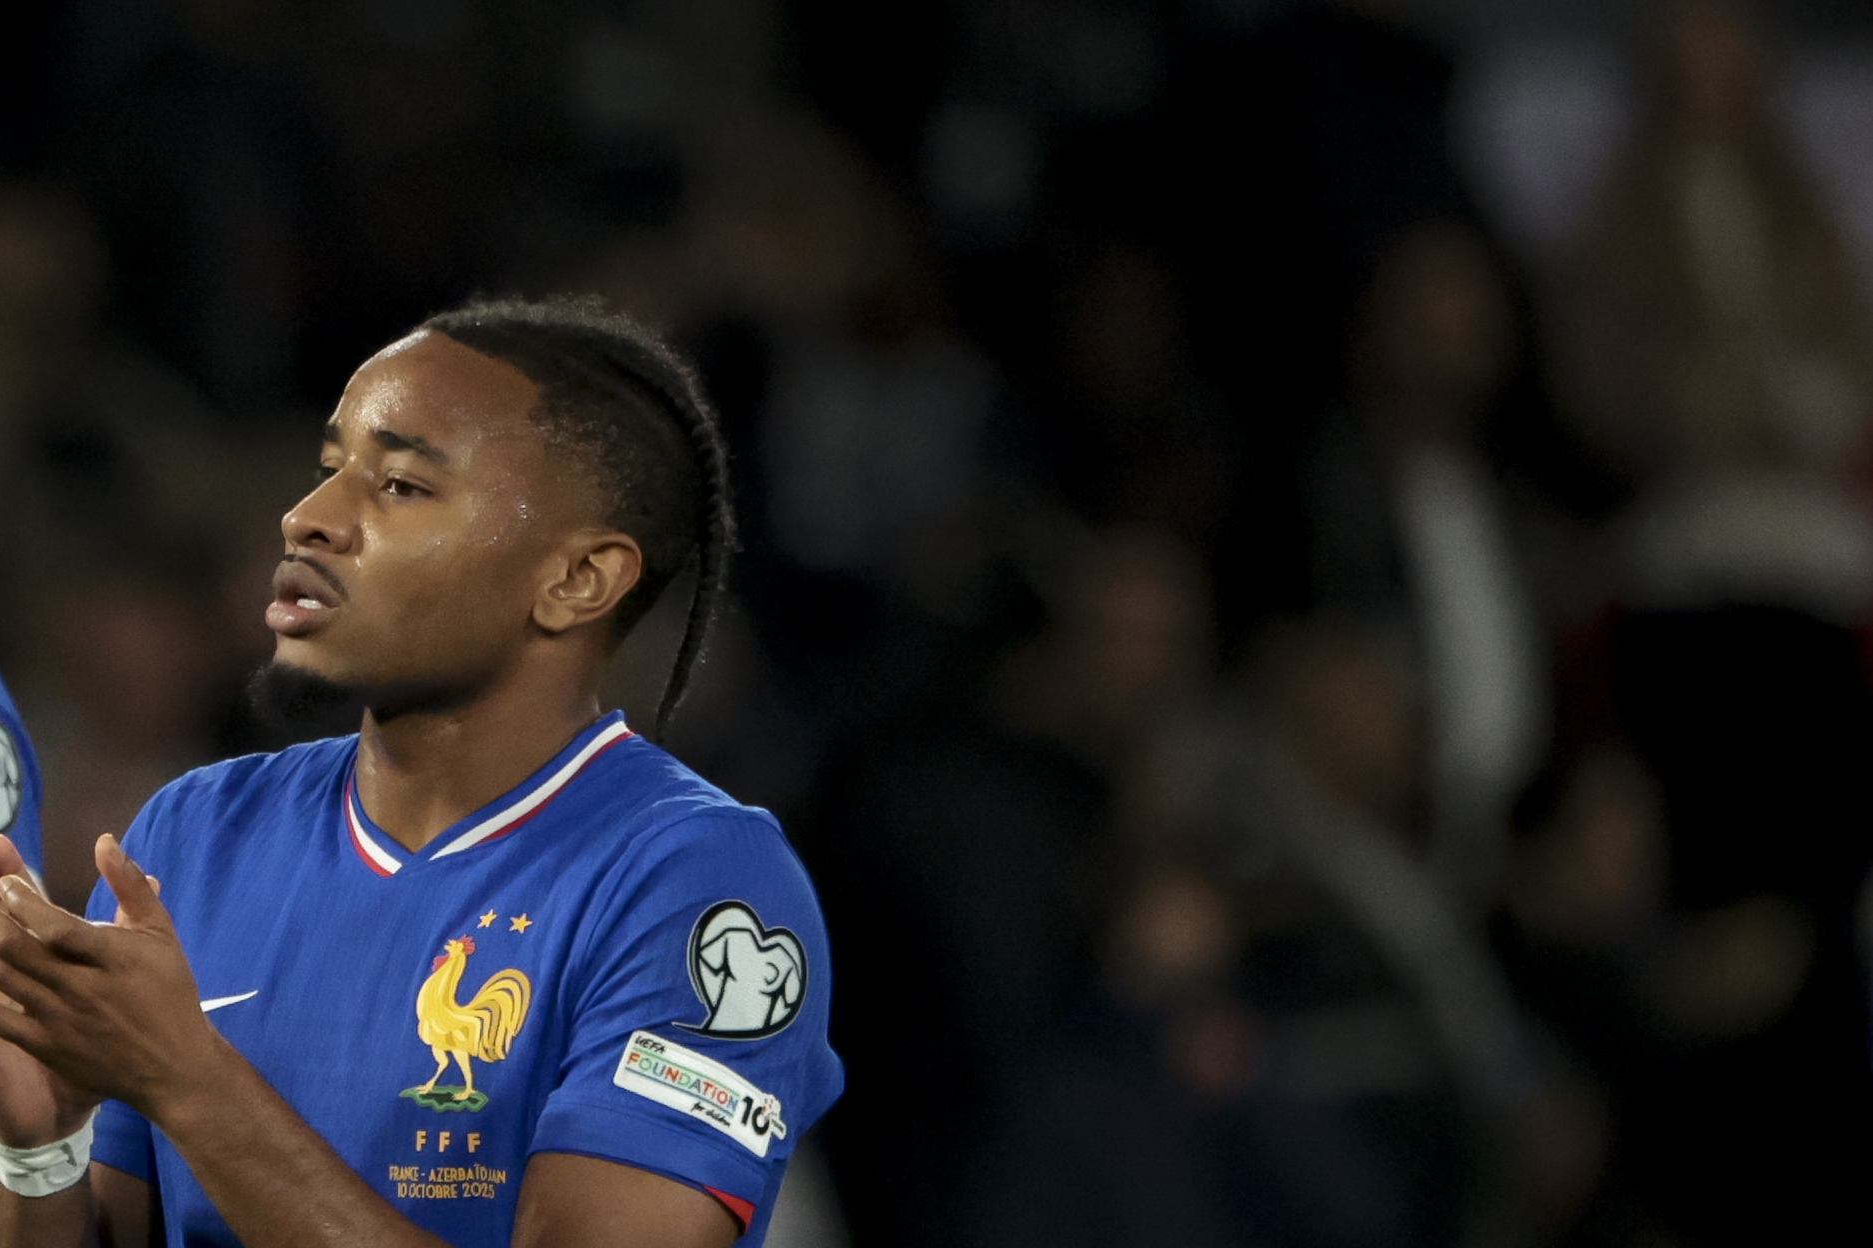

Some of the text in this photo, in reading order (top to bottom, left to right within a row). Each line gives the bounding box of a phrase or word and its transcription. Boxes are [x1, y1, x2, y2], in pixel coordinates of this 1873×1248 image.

[635, 1035, 666, 1054] UEFA
[389, 1166, 420, 1182] FRANCE
[397, 1183, 407, 1198] 10
[408, 1183, 458, 1199] OCTOBRE
